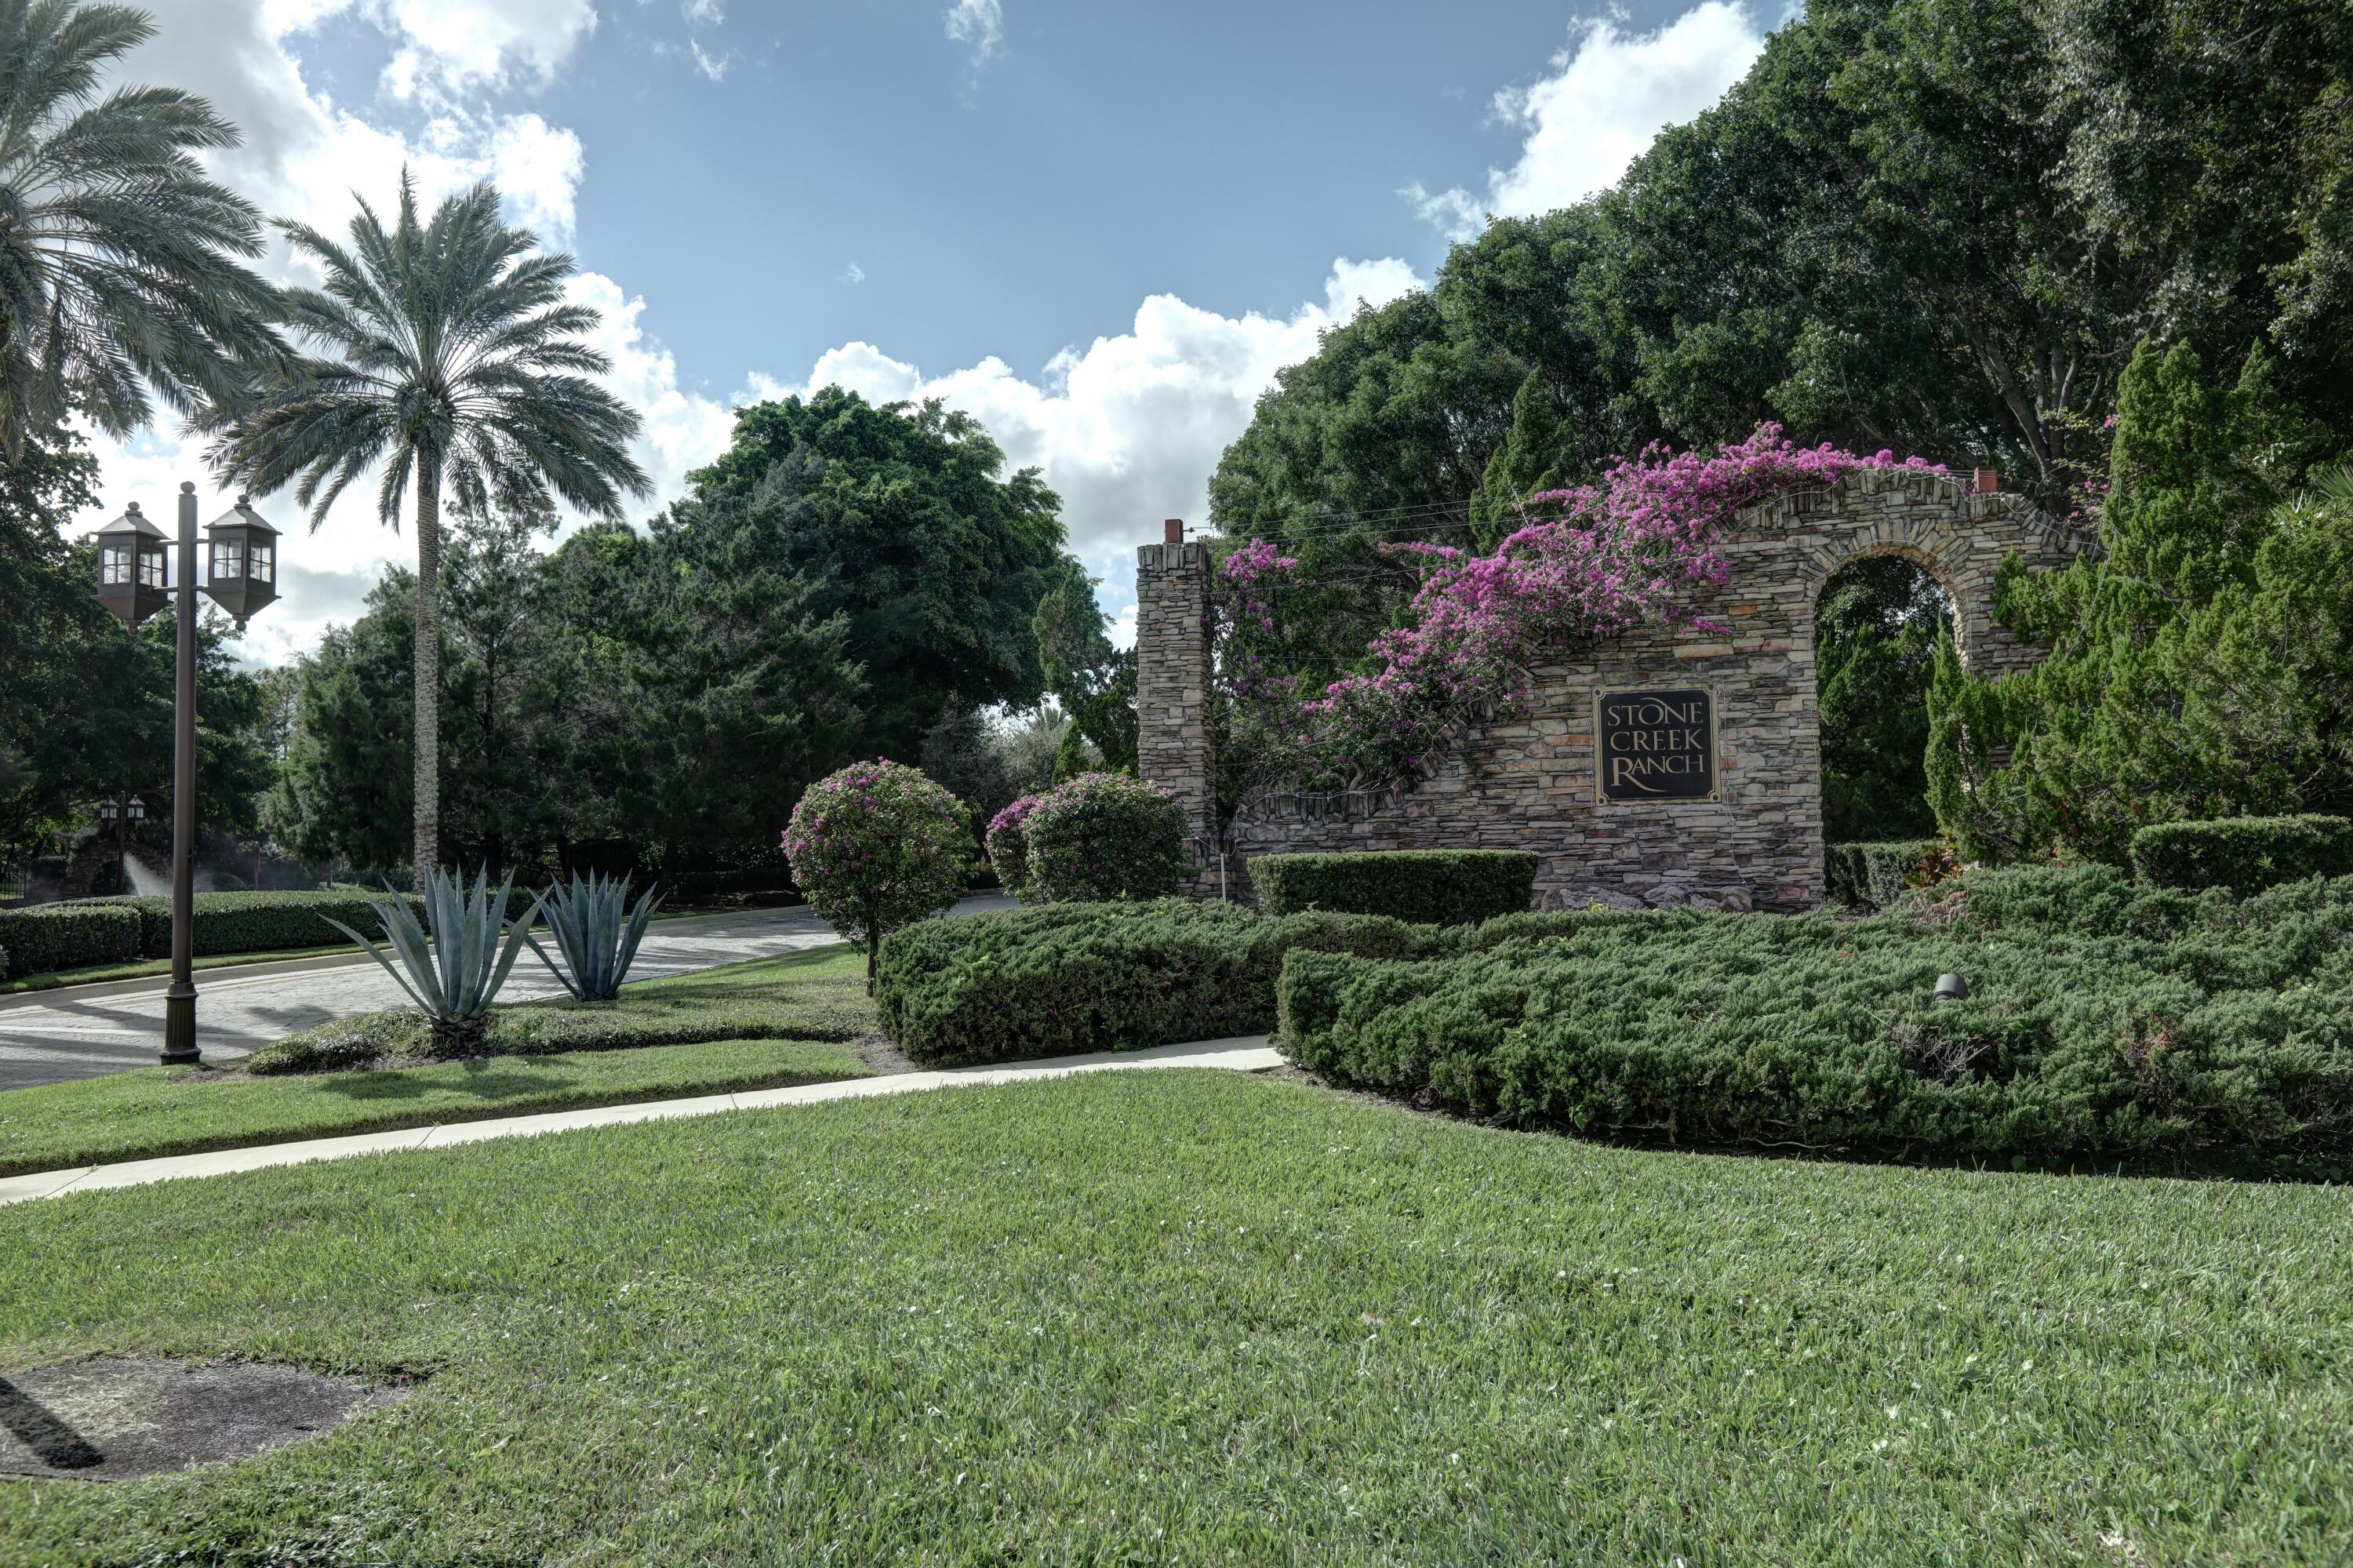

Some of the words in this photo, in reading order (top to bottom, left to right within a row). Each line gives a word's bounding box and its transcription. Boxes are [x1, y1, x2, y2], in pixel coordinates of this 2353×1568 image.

[1608, 697, 1704, 726] STONE
[1610, 729, 1704, 751] CREEK
[1610, 754, 1705, 792] RANCH
